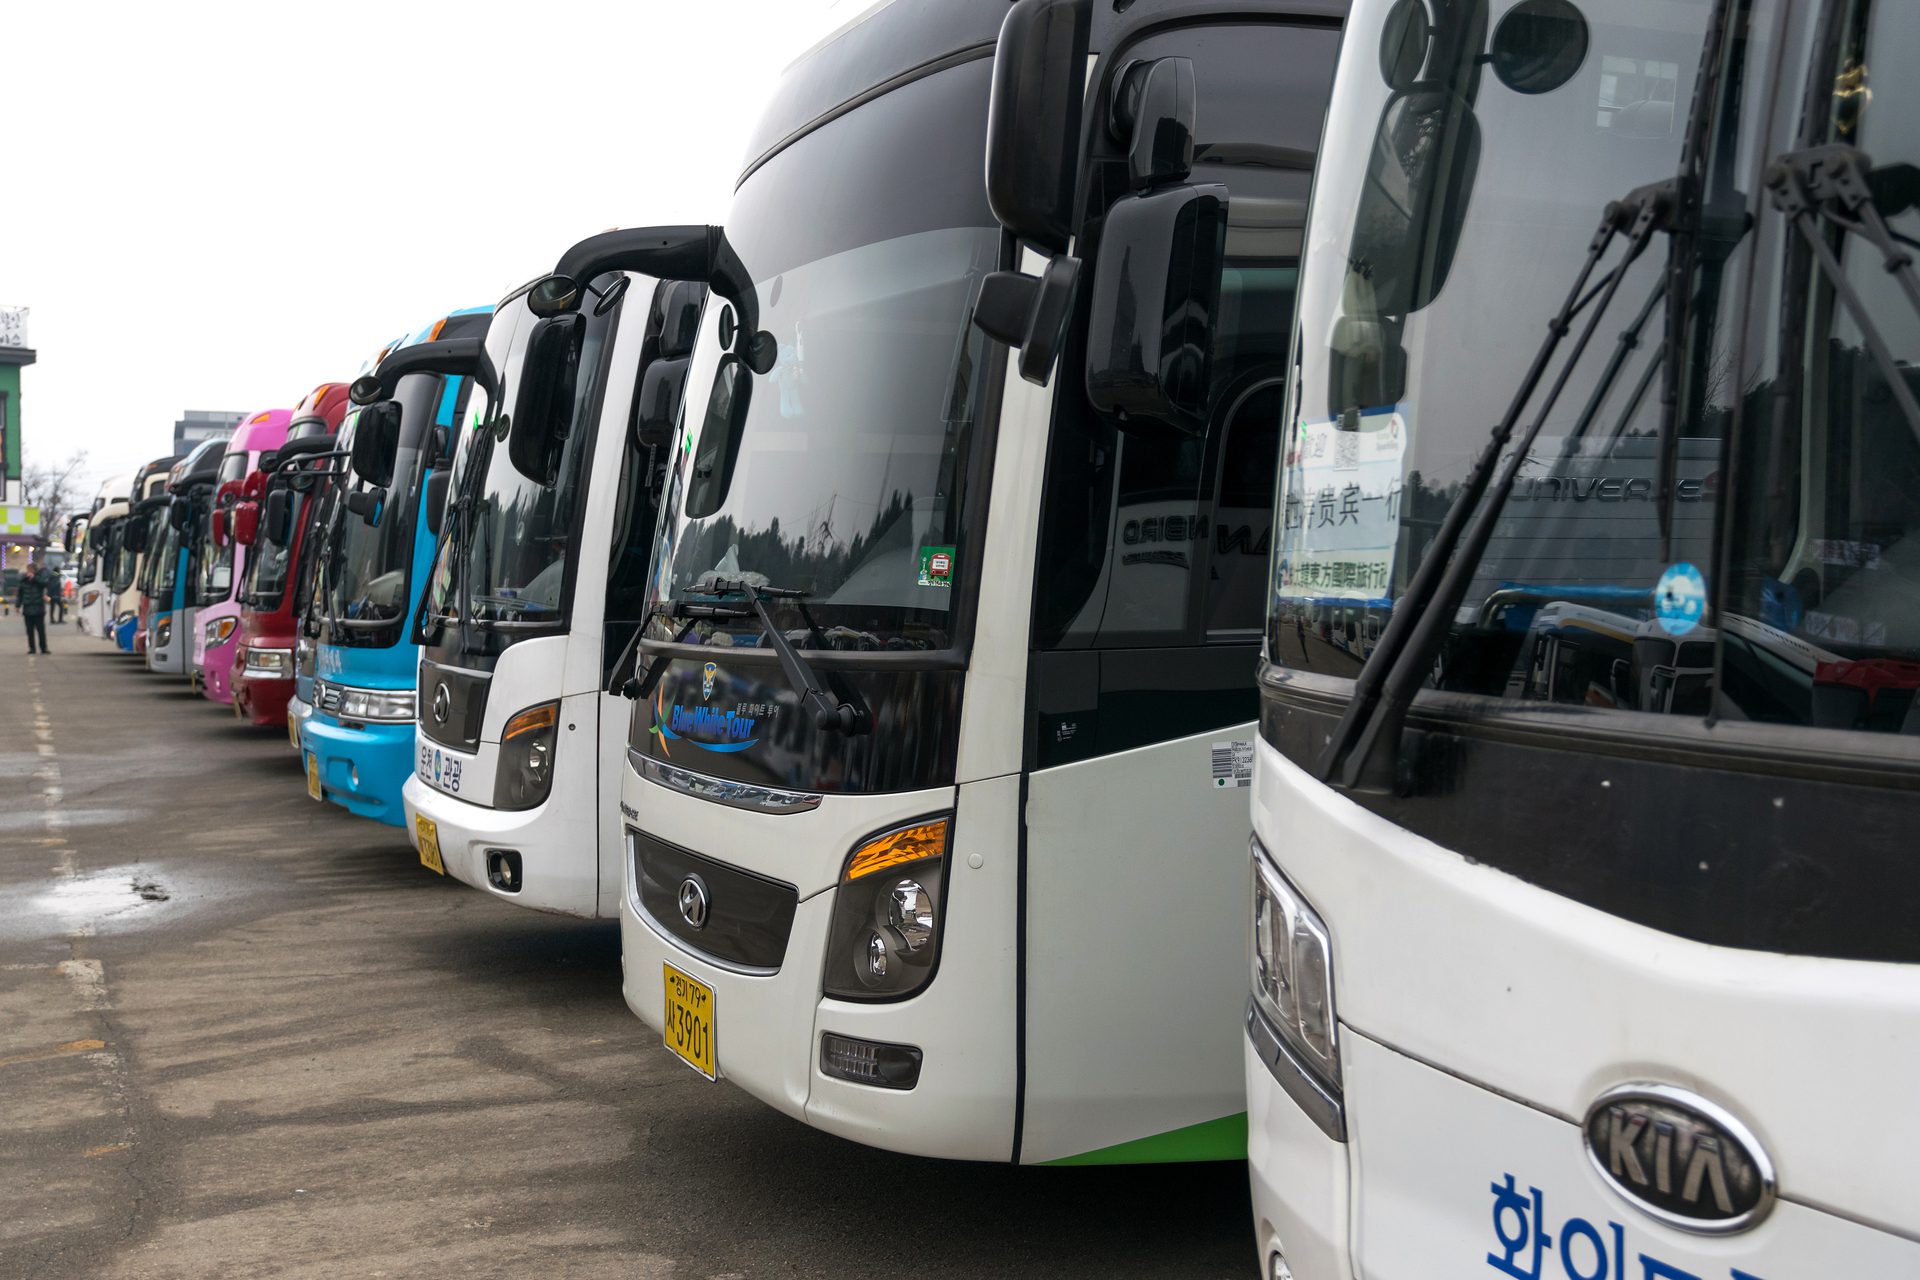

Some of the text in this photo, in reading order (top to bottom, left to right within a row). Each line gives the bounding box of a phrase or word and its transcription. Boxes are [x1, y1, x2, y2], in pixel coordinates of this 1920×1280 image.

[671, 704, 755, 738] Blue White Tour
[443, 757, 462, 792] 관광
[1608, 1104, 1734, 1214] KIA
